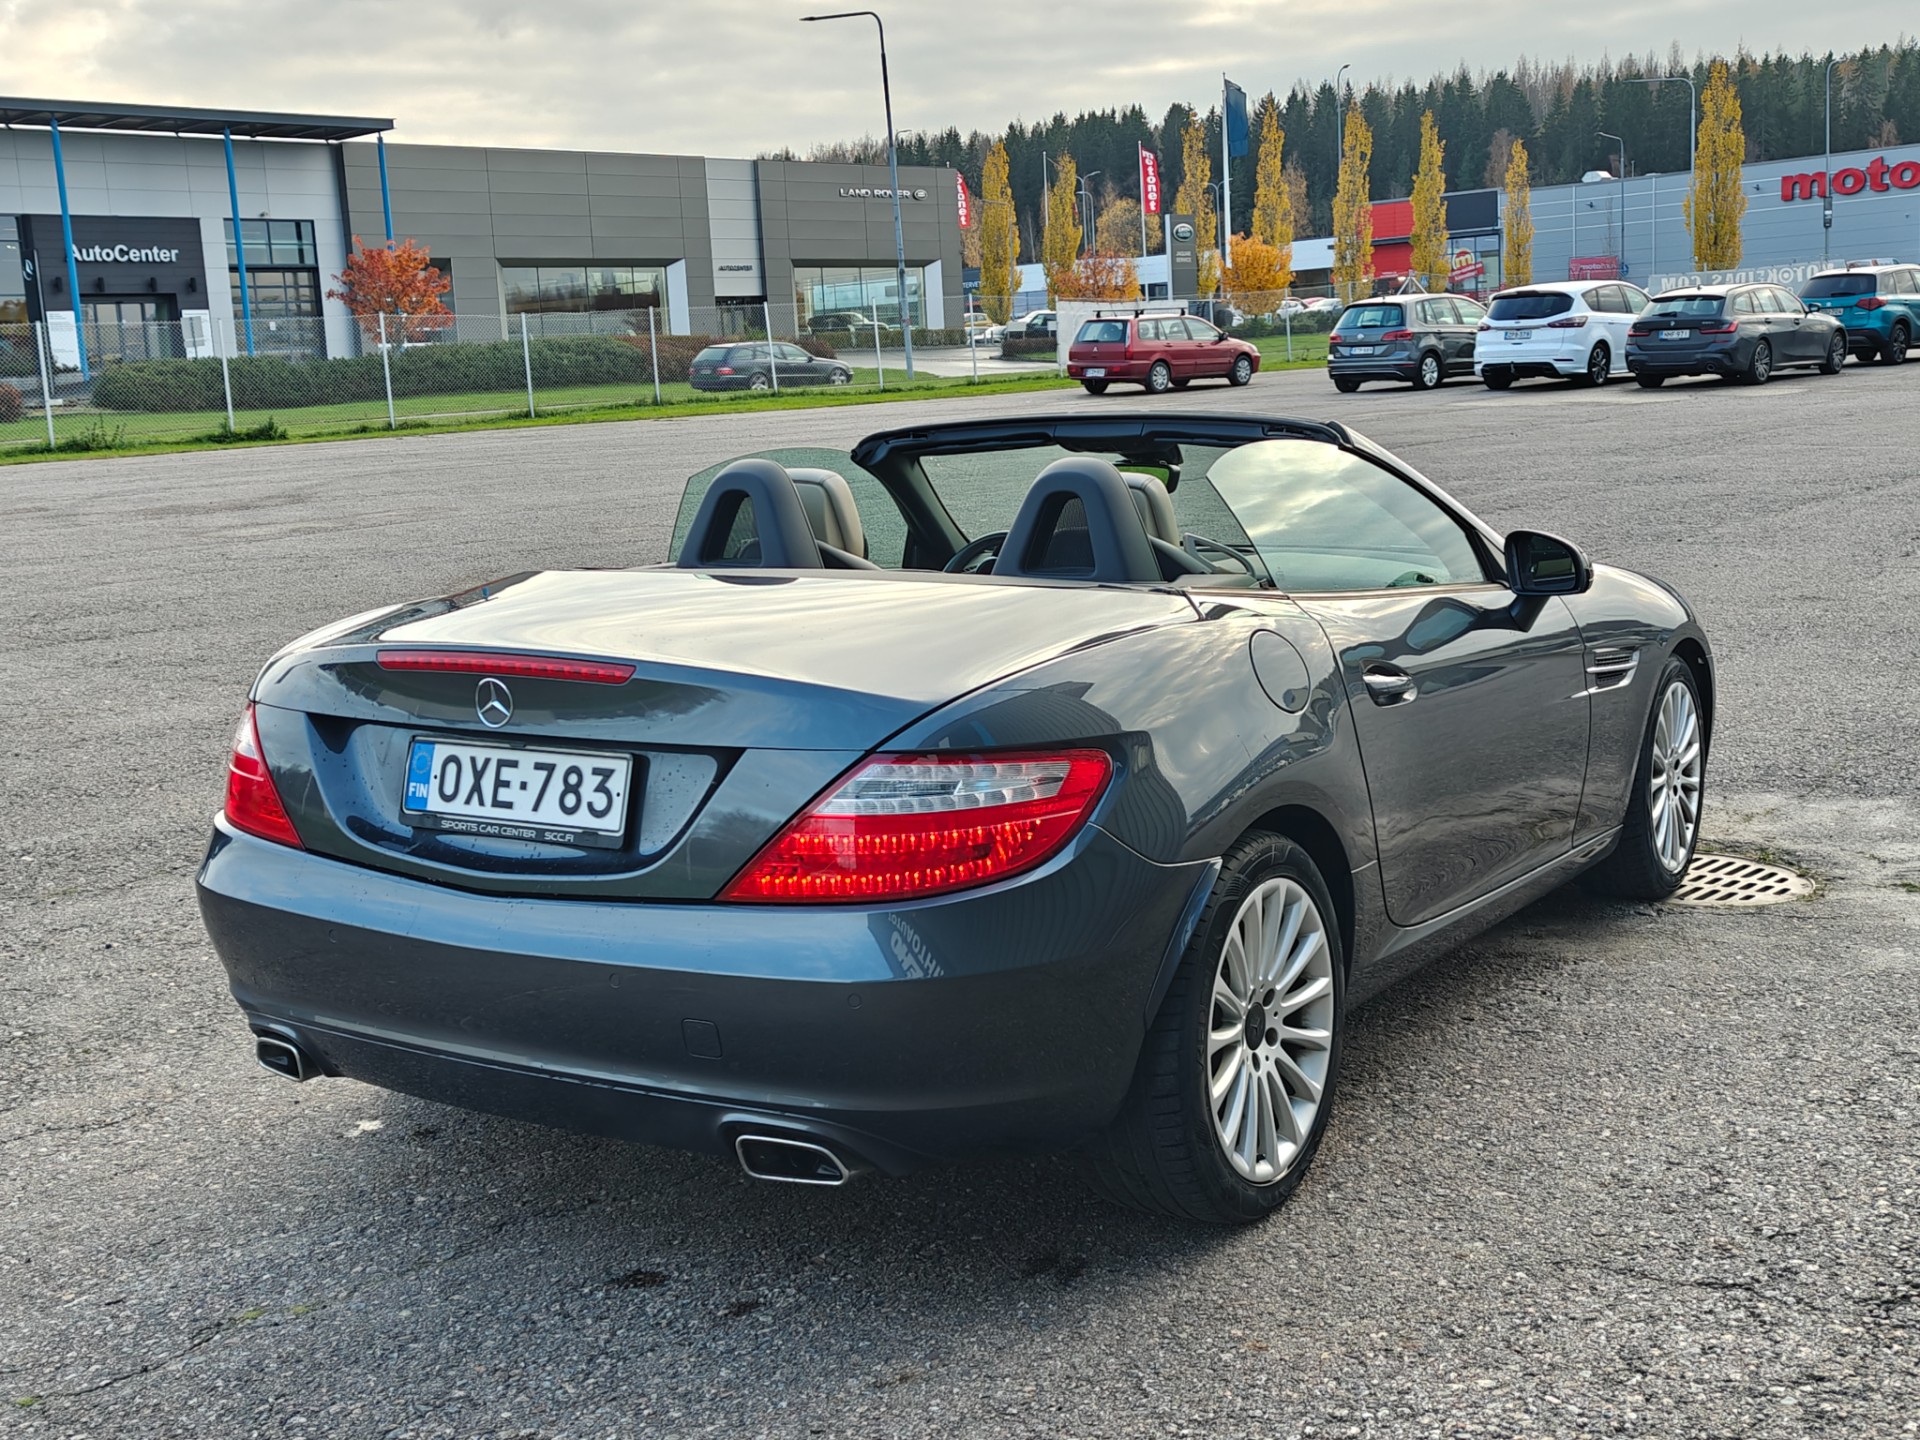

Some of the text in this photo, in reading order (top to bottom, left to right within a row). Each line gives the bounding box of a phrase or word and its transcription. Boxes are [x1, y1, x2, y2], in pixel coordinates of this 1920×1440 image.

[839, 187, 871, 198] LAND
[1141, 150, 1158, 211] motonet
[1781, 156, 1920, 202] moto
[72, 243, 179, 262] AutoCenter
[408, 754, 616, 819] FIN OXE-783
[440, 819, 478, 832] SPORTS
[479, 823, 500, 834] CAR
[500, 827, 537, 839] CENTER
